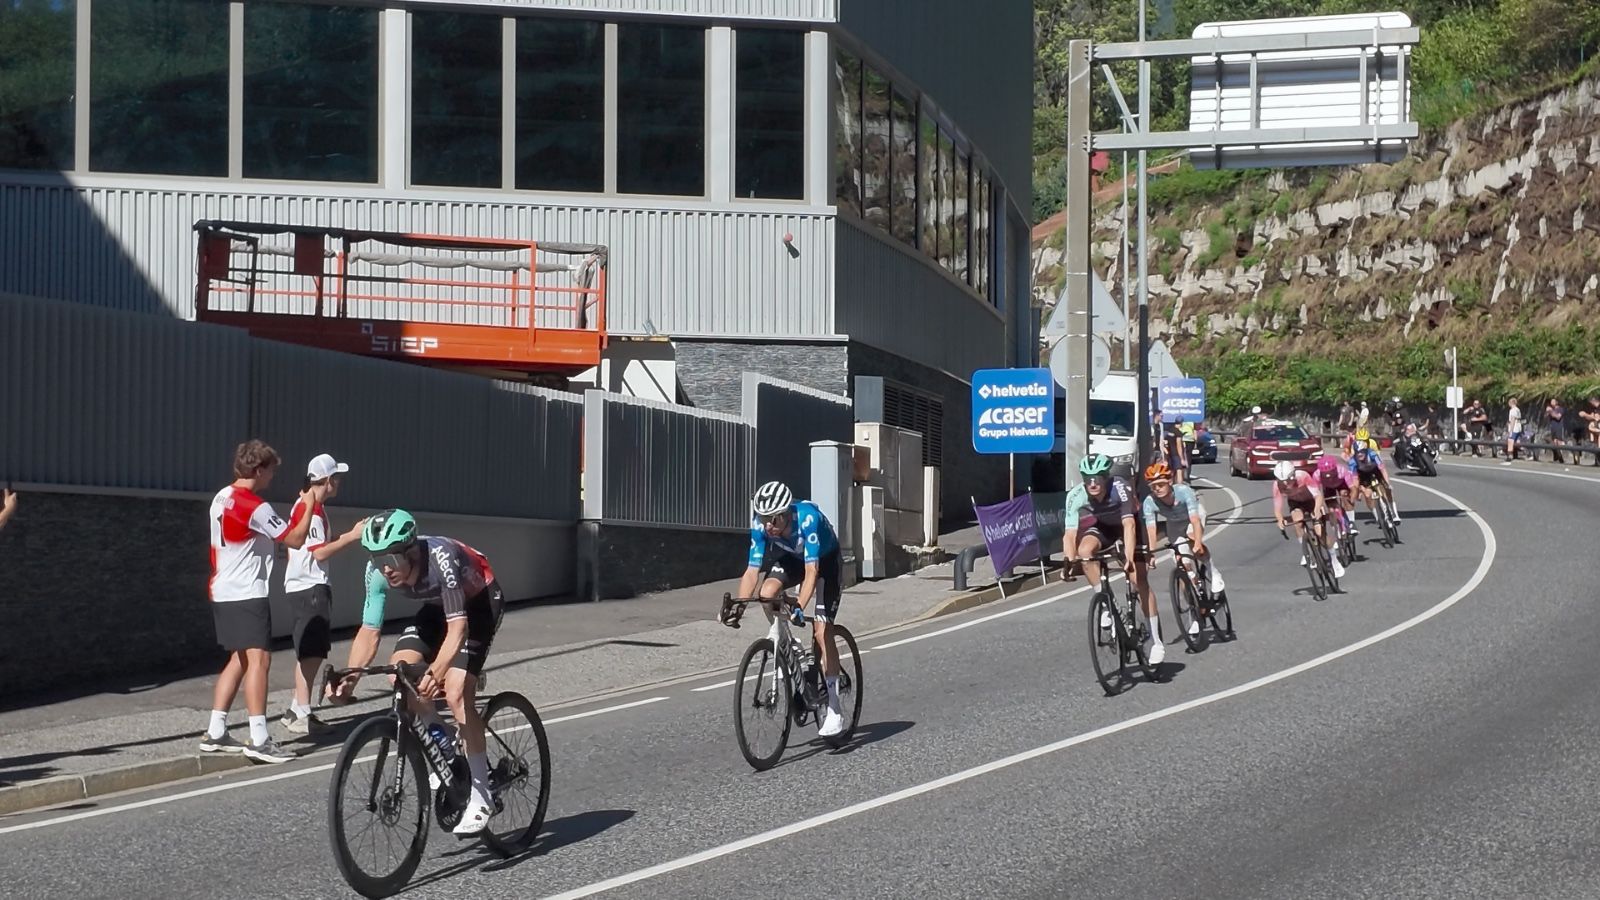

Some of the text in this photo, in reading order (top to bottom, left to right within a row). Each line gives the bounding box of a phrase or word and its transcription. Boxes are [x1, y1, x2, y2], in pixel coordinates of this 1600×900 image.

[992, 382, 1048, 397] helvetia
[991, 406, 1048, 424] caser
[978, 426, 1049, 439] Grupo Helvetia
[430, 545, 458, 589] Adecco
[411, 713, 434, 748] VAN
[427, 743, 455, 787] RYSEL
